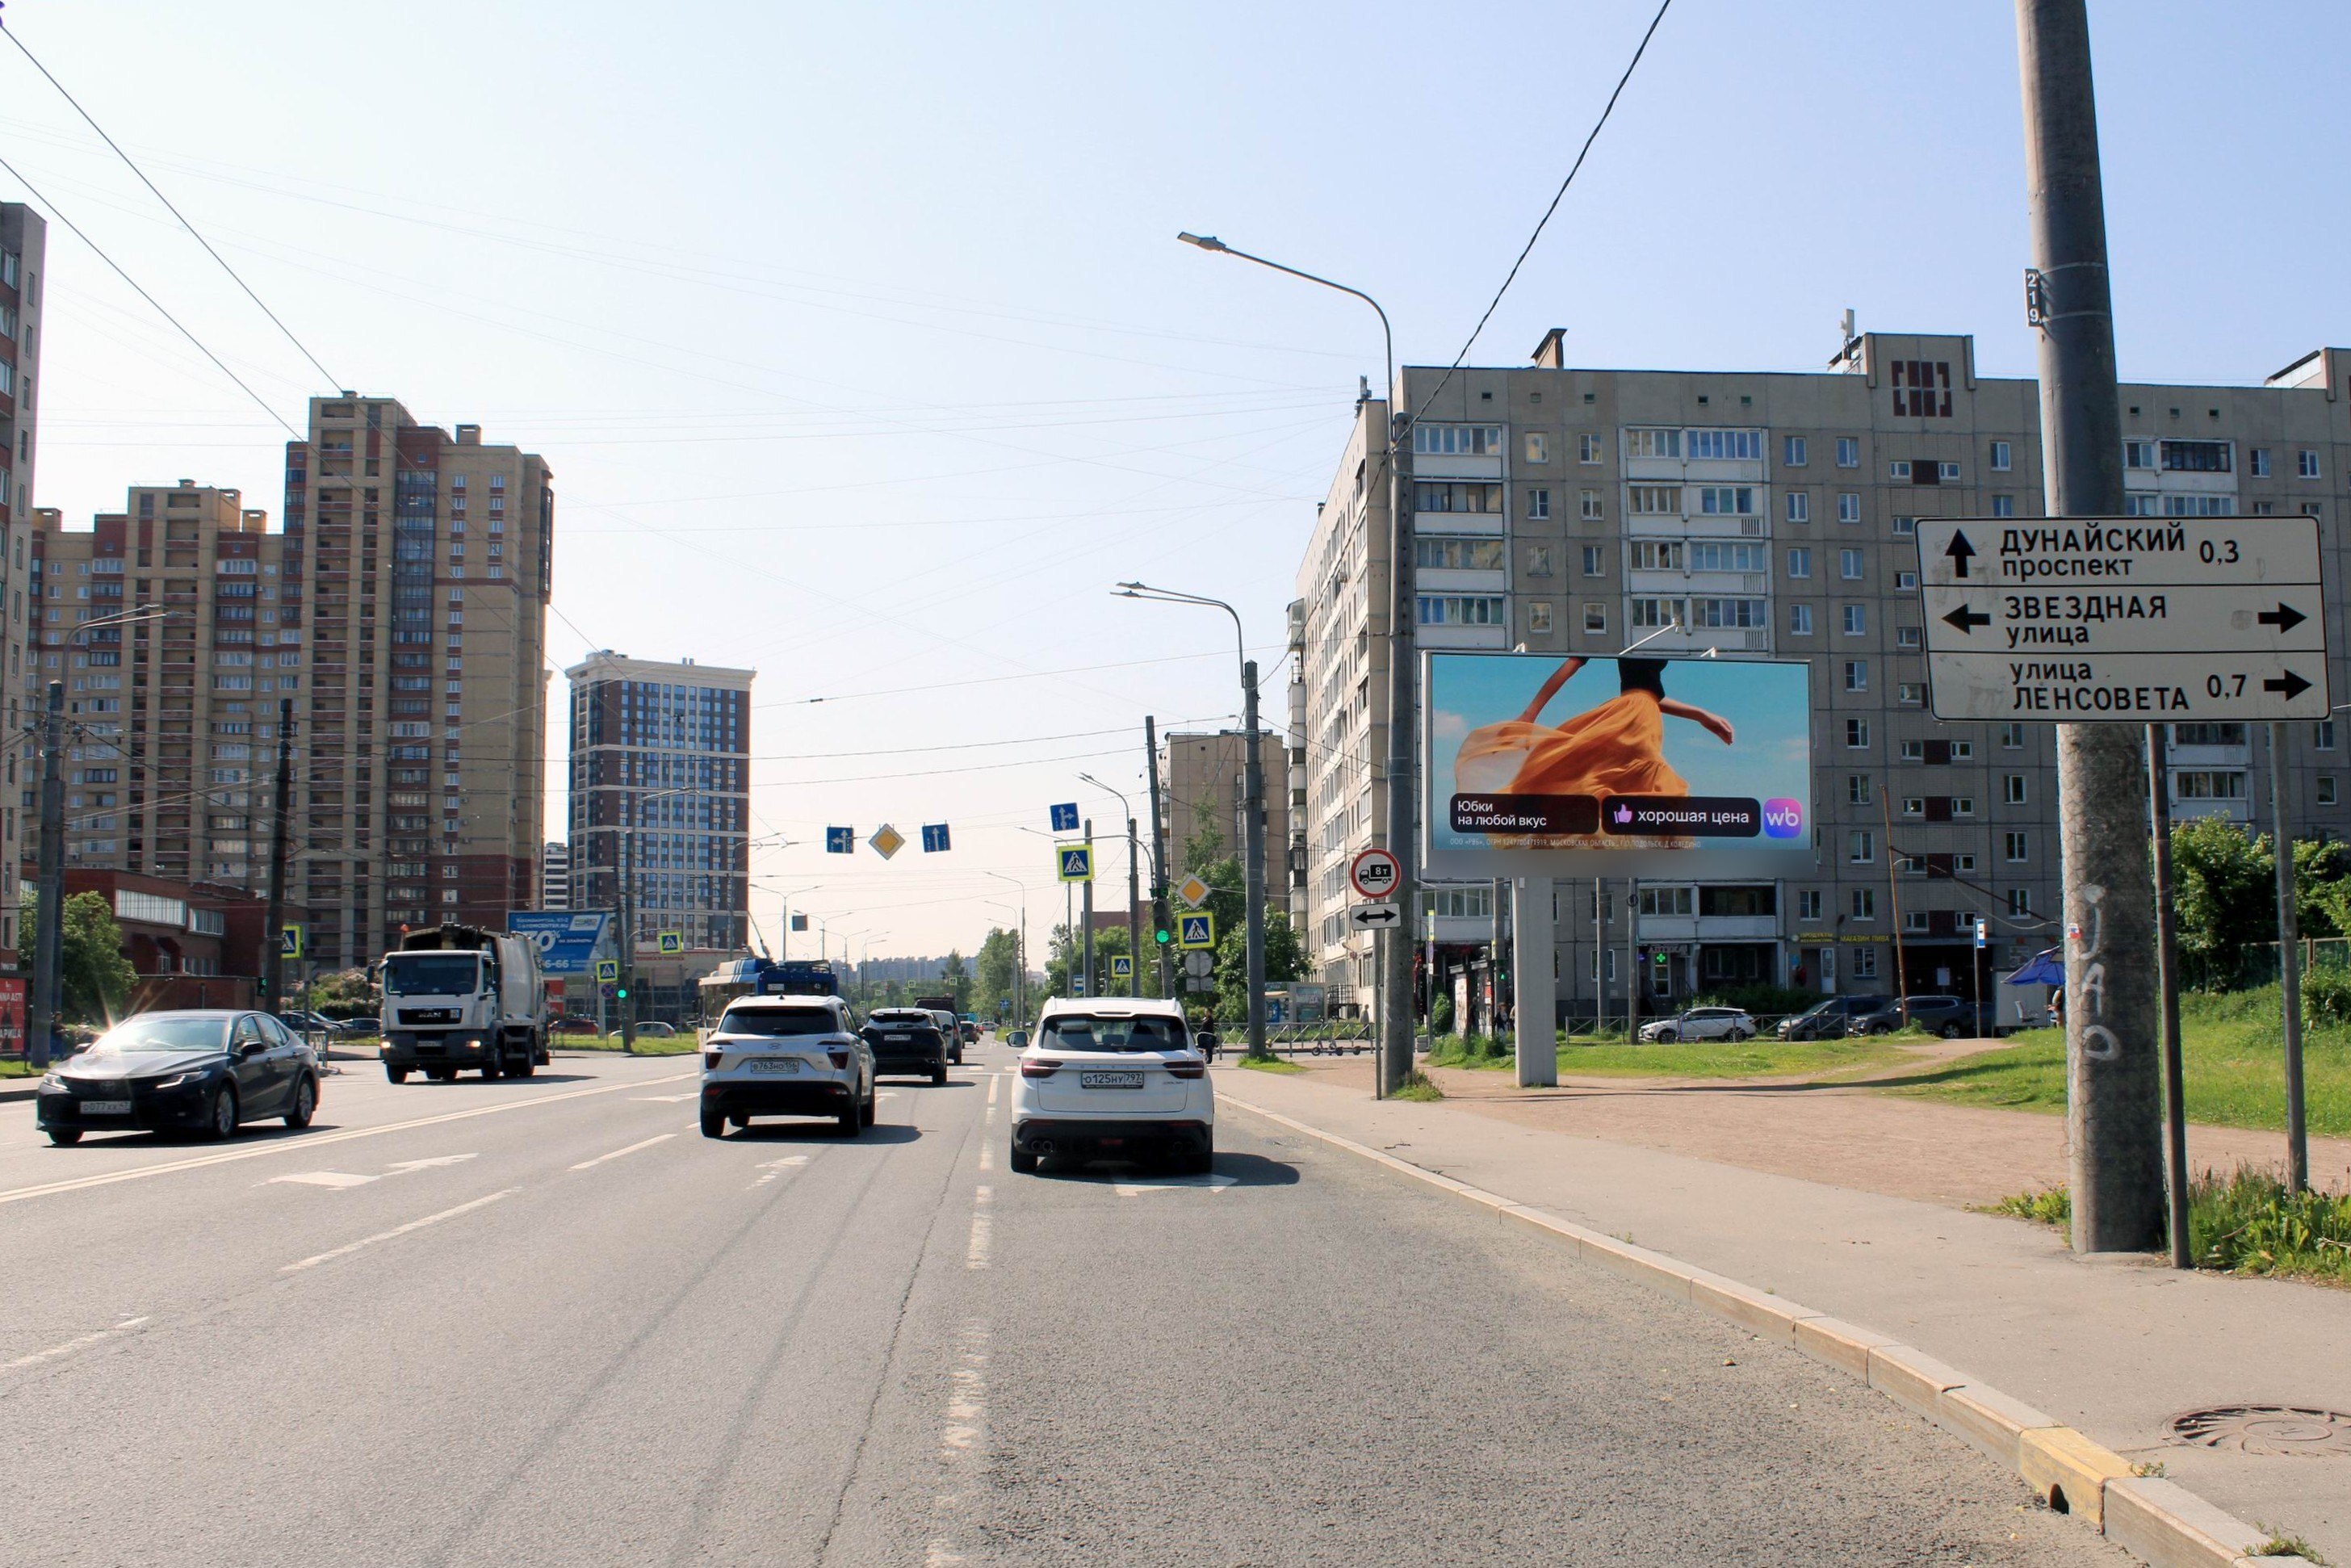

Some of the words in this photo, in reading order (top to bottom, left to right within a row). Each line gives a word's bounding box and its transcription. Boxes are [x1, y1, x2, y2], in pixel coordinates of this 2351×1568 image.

[2026, 273, 2039, 323] 219
[2000, 522, 2185, 556] ДУНАЙСКИЙ
[2199, 539, 2240, 565] 0,3
[2002, 556, 2134, 582] проспект
[2005, 596, 2167, 623] ЗВЕЗДНАЯ
[2005, 625, 2089, 648] улица
[2009, 662, 2093, 685] улица
[2013, 687, 2190, 711] ЛЕНСОВЕТА
[2206, 674, 2248, 699] 0,7
[1457, 800, 1494, 813] Юбки
[1637, 811, 1707, 825] хорошая
[1711, 811, 1750, 825] цена
[1457, 816, 1473, 826] на
[1475, 813, 1515, 827] любой
[1519, 817, 1547, 829] вкус
[1766, 809, 1800, 828] wb
